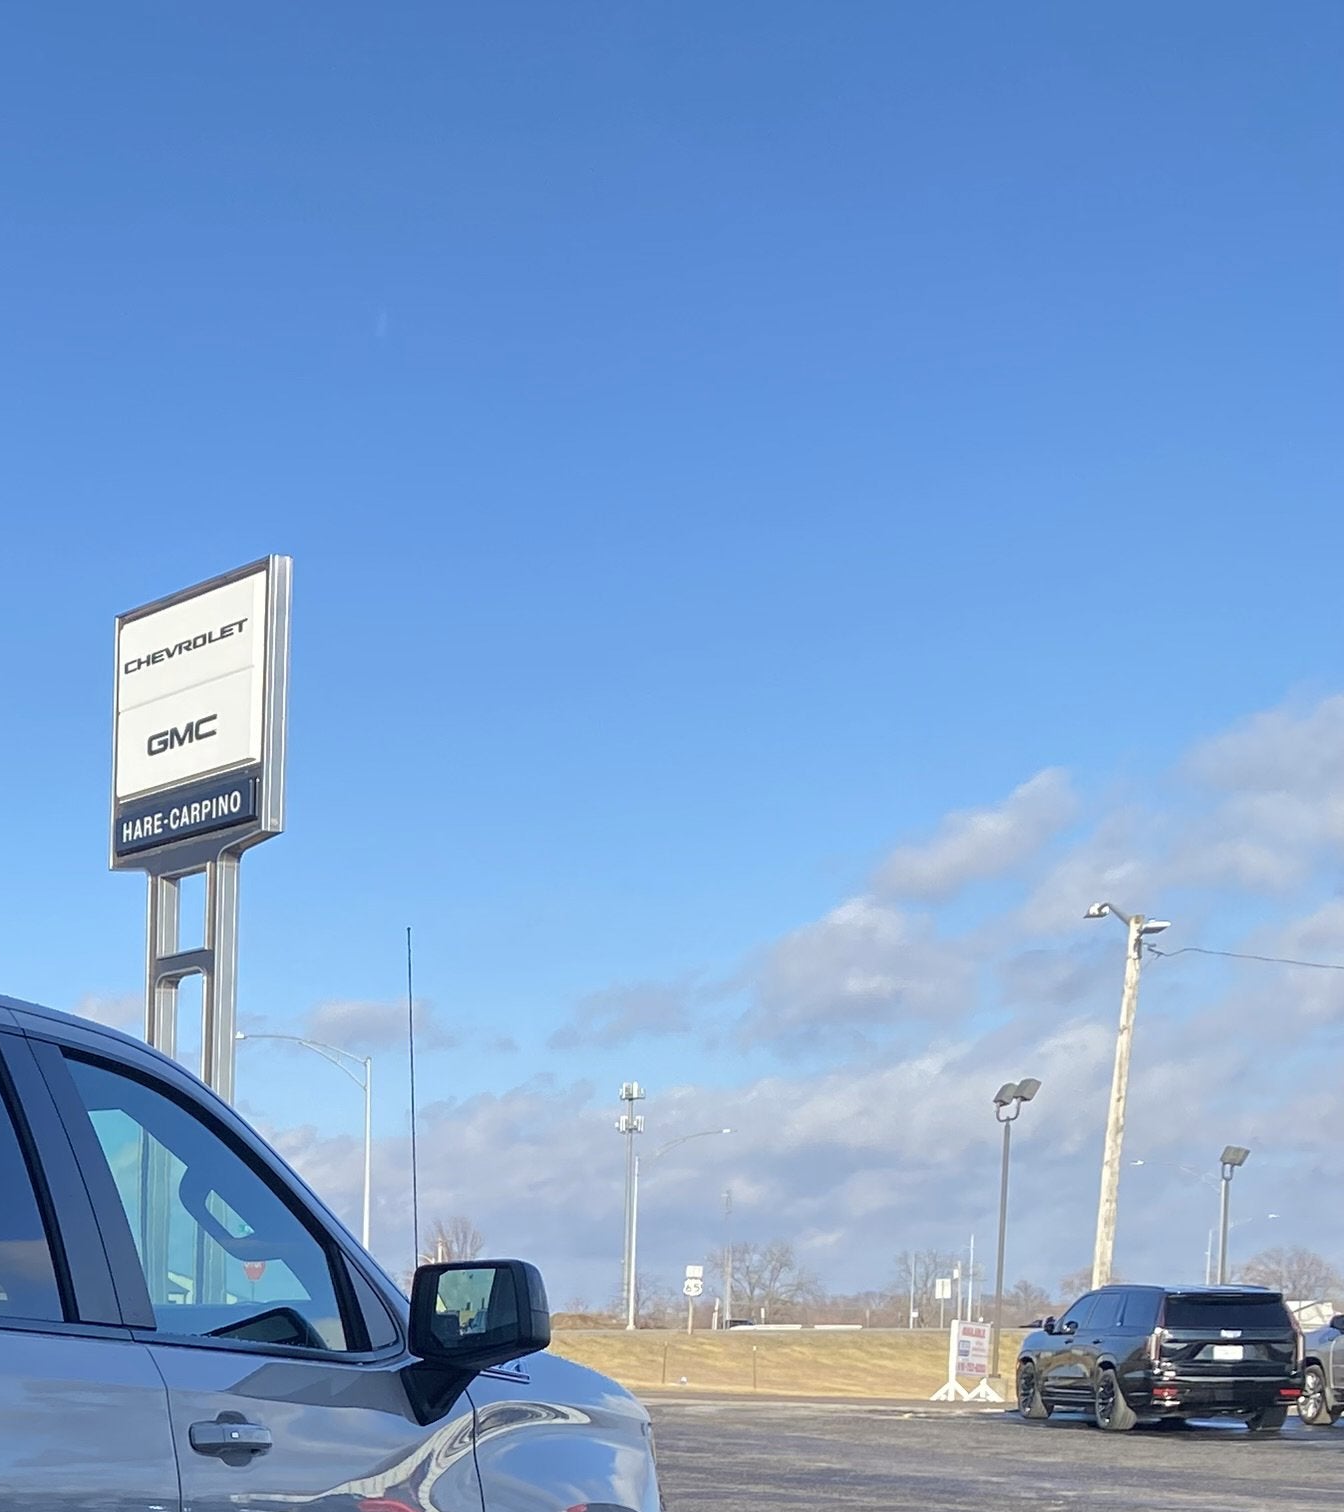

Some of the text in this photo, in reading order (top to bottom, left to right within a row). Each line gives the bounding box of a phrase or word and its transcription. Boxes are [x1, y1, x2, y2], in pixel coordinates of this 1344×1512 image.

[124, 618, 248, 675] CHEVROLET
[147, 713, 218, 757] GMC
[122, 790, 242, 843] HARE-CARPINO
